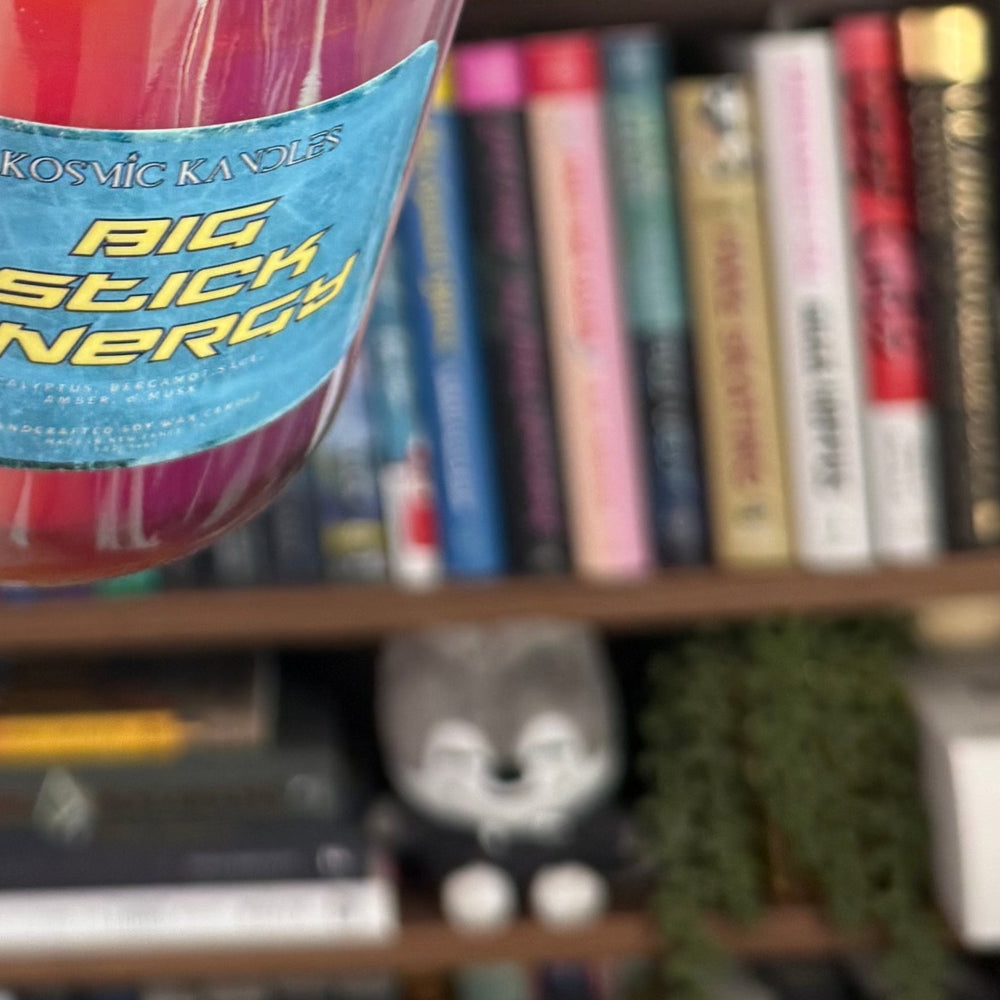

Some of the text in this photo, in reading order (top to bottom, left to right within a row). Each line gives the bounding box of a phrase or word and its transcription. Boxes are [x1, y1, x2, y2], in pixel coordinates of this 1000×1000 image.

[0, 123, 345, 189] KOSMIC KANDLES
[69, 196, 284, 257] BIG
